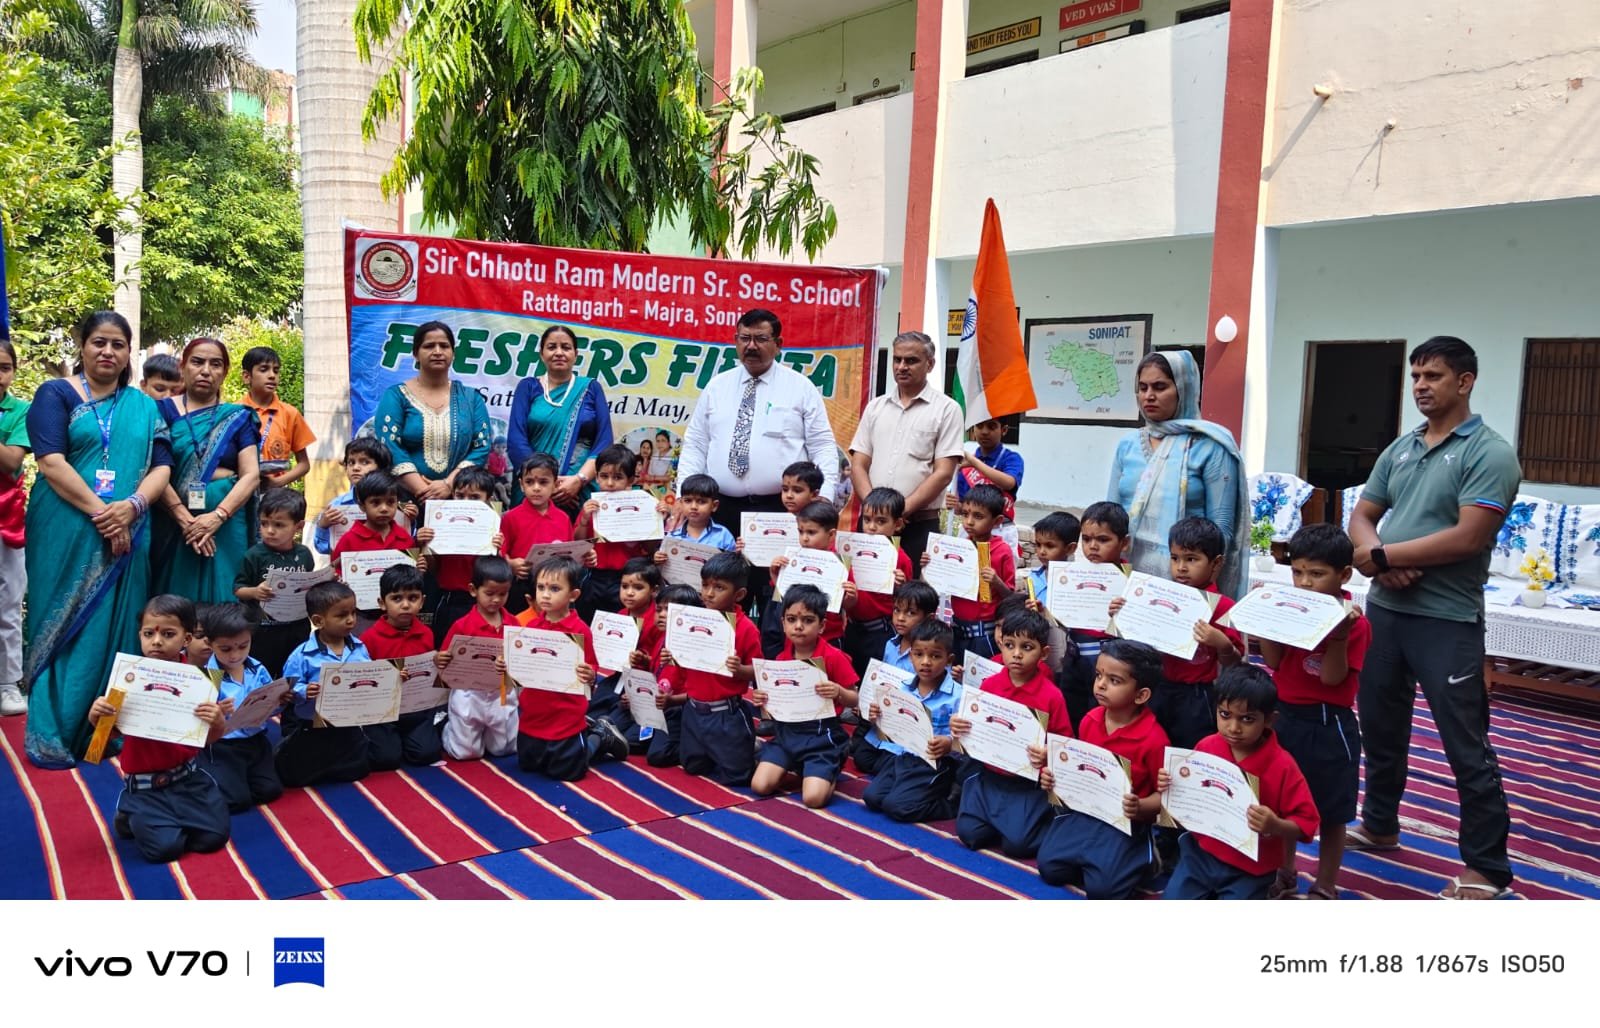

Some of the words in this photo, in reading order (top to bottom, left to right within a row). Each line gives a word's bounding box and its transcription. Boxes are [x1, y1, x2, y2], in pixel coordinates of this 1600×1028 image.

[1064, 9, 1086, 23] VED
[1089, 2, 1116, 16] VYAS
[966, 39, 978, 52] AND
[979, 34, 995, 48] THAT
[996, 29, 1016, 44] FEEDS
[1017, 23, 1032, 39] YOU
[424, 247, 456, 275] Sir
[466, 251, 546, 283] Chhotu
[555, 259, 604, 288] Ram
[612, 263, 696, 295] Modern
[703, 271, 731, 299] Sr.
[739, 274, 782, 302] Sec.
[790, 278, 861, 308] School
[522, 290, 623, 321] Rattangarh
[644, 299, 699, 327] Majra,
[705, 305, 742, 326] Soni
[1088, 326, 1132, 340] SONIPAT
[381, 322, 657, 388] FESHRS
[477, 386, 515, 407] Sat
[634, 398, 691, 424] May,
